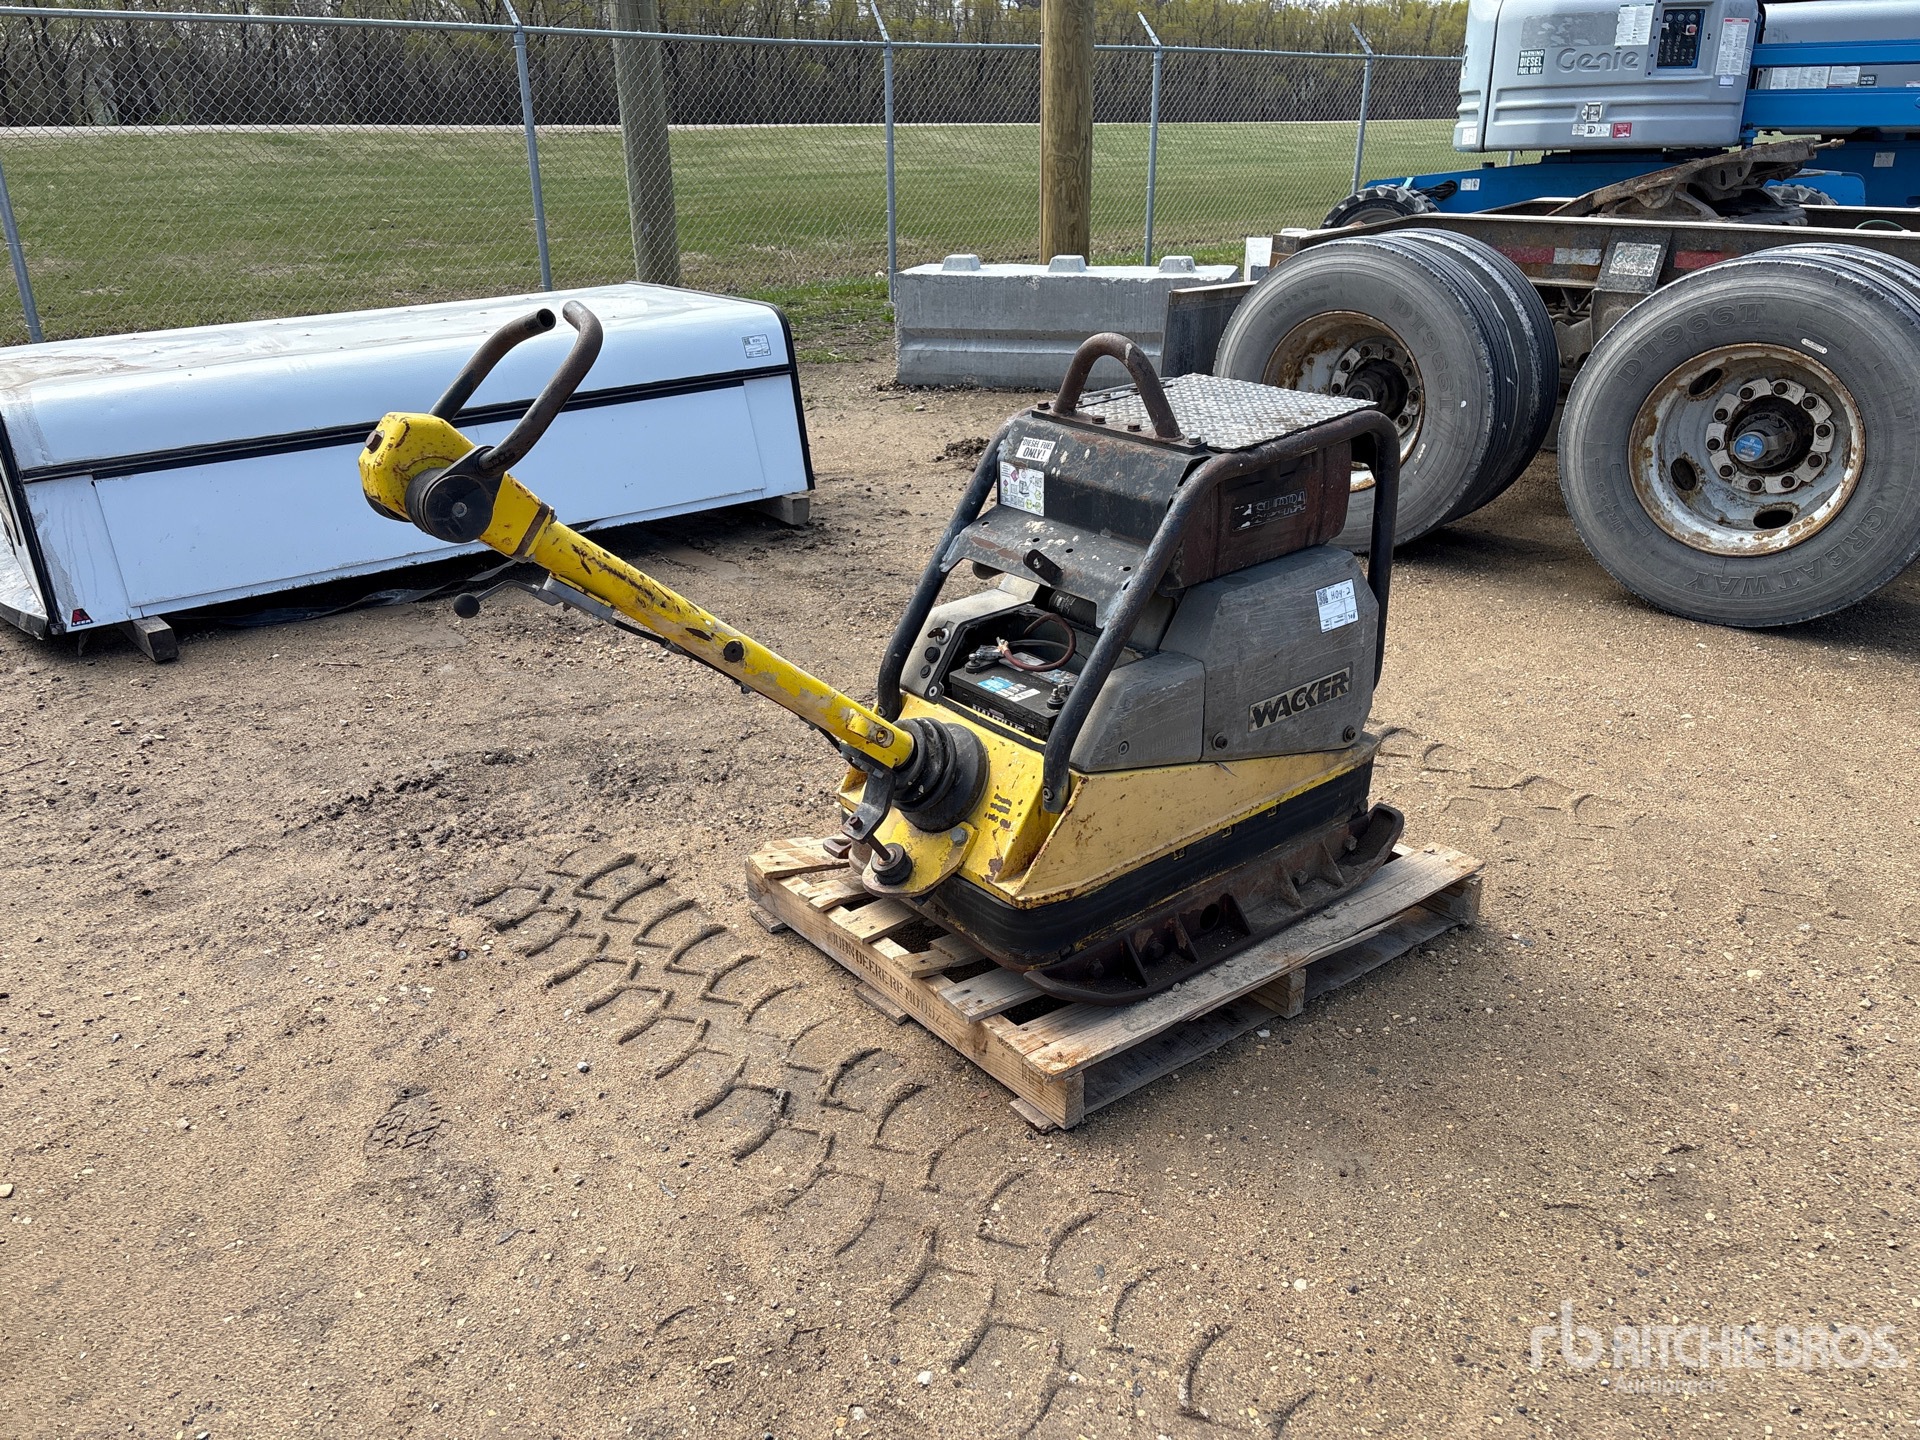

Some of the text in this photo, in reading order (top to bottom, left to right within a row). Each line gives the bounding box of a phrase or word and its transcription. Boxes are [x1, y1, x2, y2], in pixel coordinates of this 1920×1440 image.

[1519, 56, 1543, 66] DIESEL
[1556, 47, 1639, 73] Genie
[1518, 66, 1542, 75] FUEL ONLY
[1615, 302, 1766, 386] DT966T
[1022, 438, 1054, 450] DIESEL FUEL
[1022, 446, 1046, 460] ONLY!
[1685, 505, 1890, 596] GREATWAY
[1252, 670, 1350, 730] WACKER
